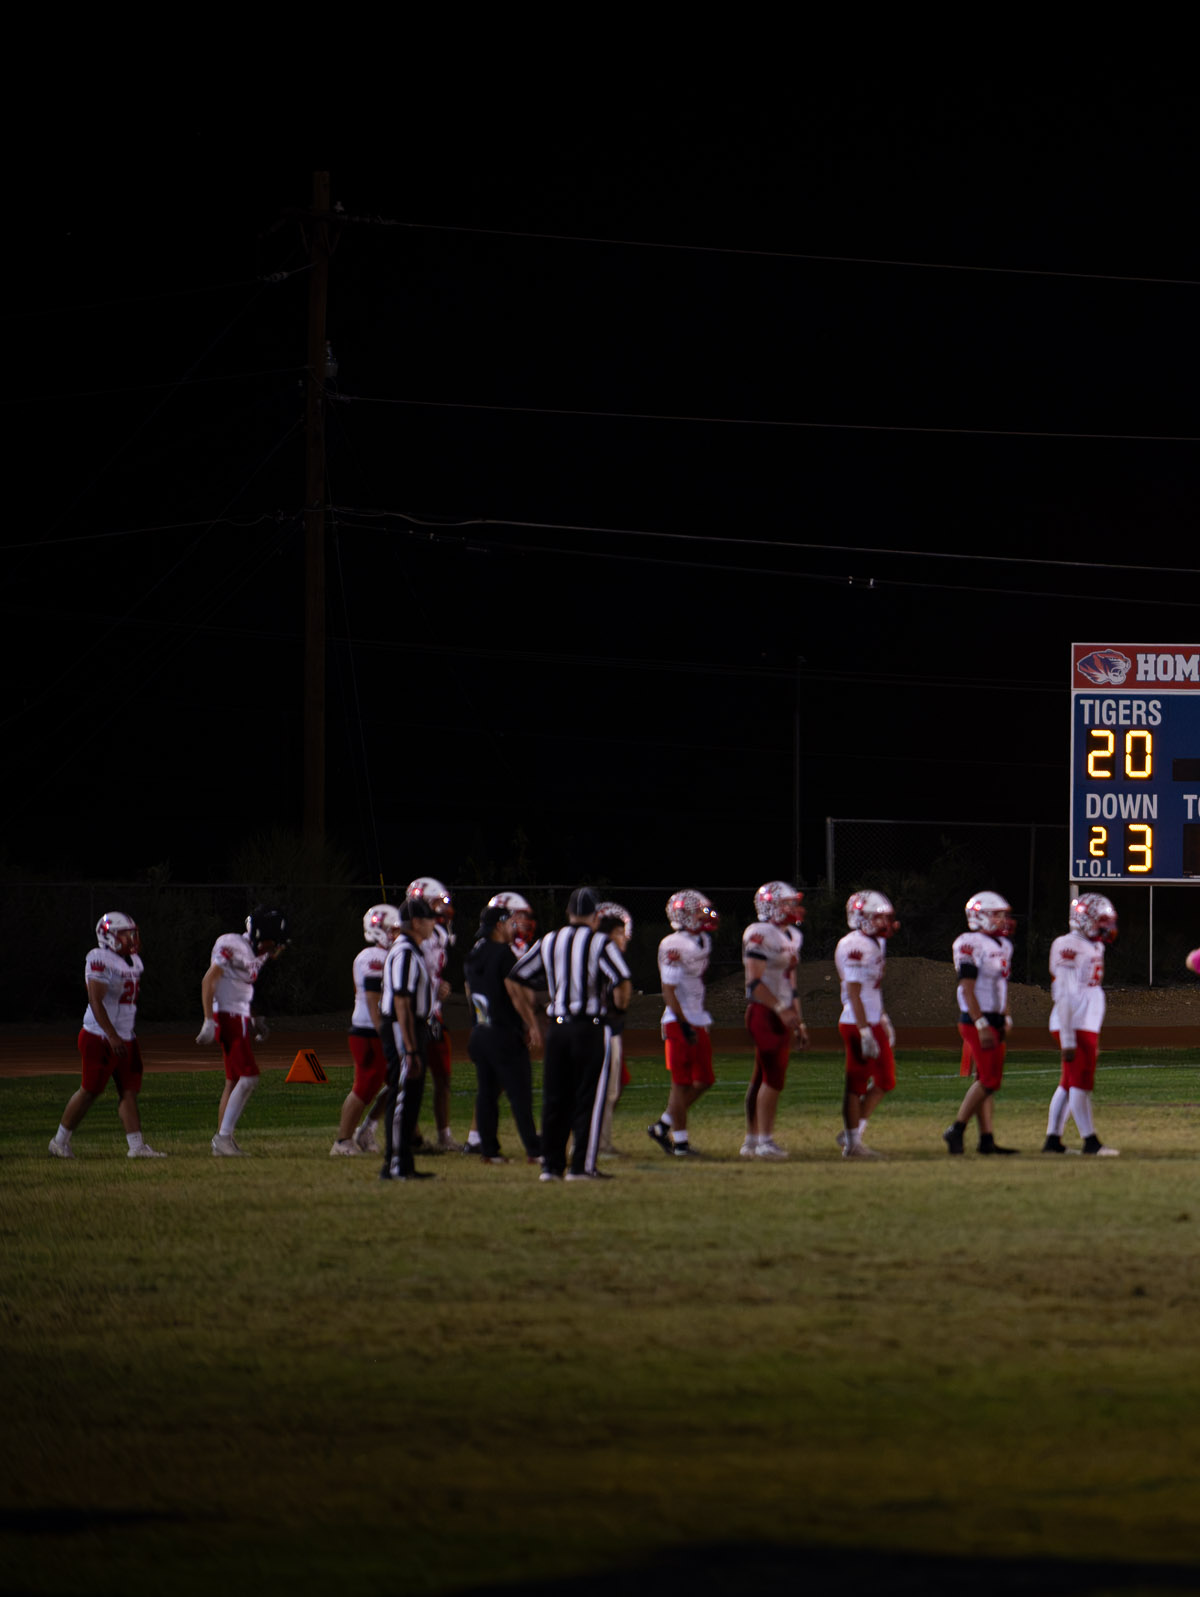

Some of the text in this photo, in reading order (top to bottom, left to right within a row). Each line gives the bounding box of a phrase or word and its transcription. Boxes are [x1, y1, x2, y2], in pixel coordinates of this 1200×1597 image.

[1079, 699, 1163, 726] TIGERS
[1087, 729, 1153, 778] 20
[1085, 793, 1158, 820] DOWN
[1088, 826, 1107, 857] 2
[1127, 823, 1153, 873] 3
[1076, 859, 1122, 878] T.O.L.
[304, 1054, 327, 1081] 10
